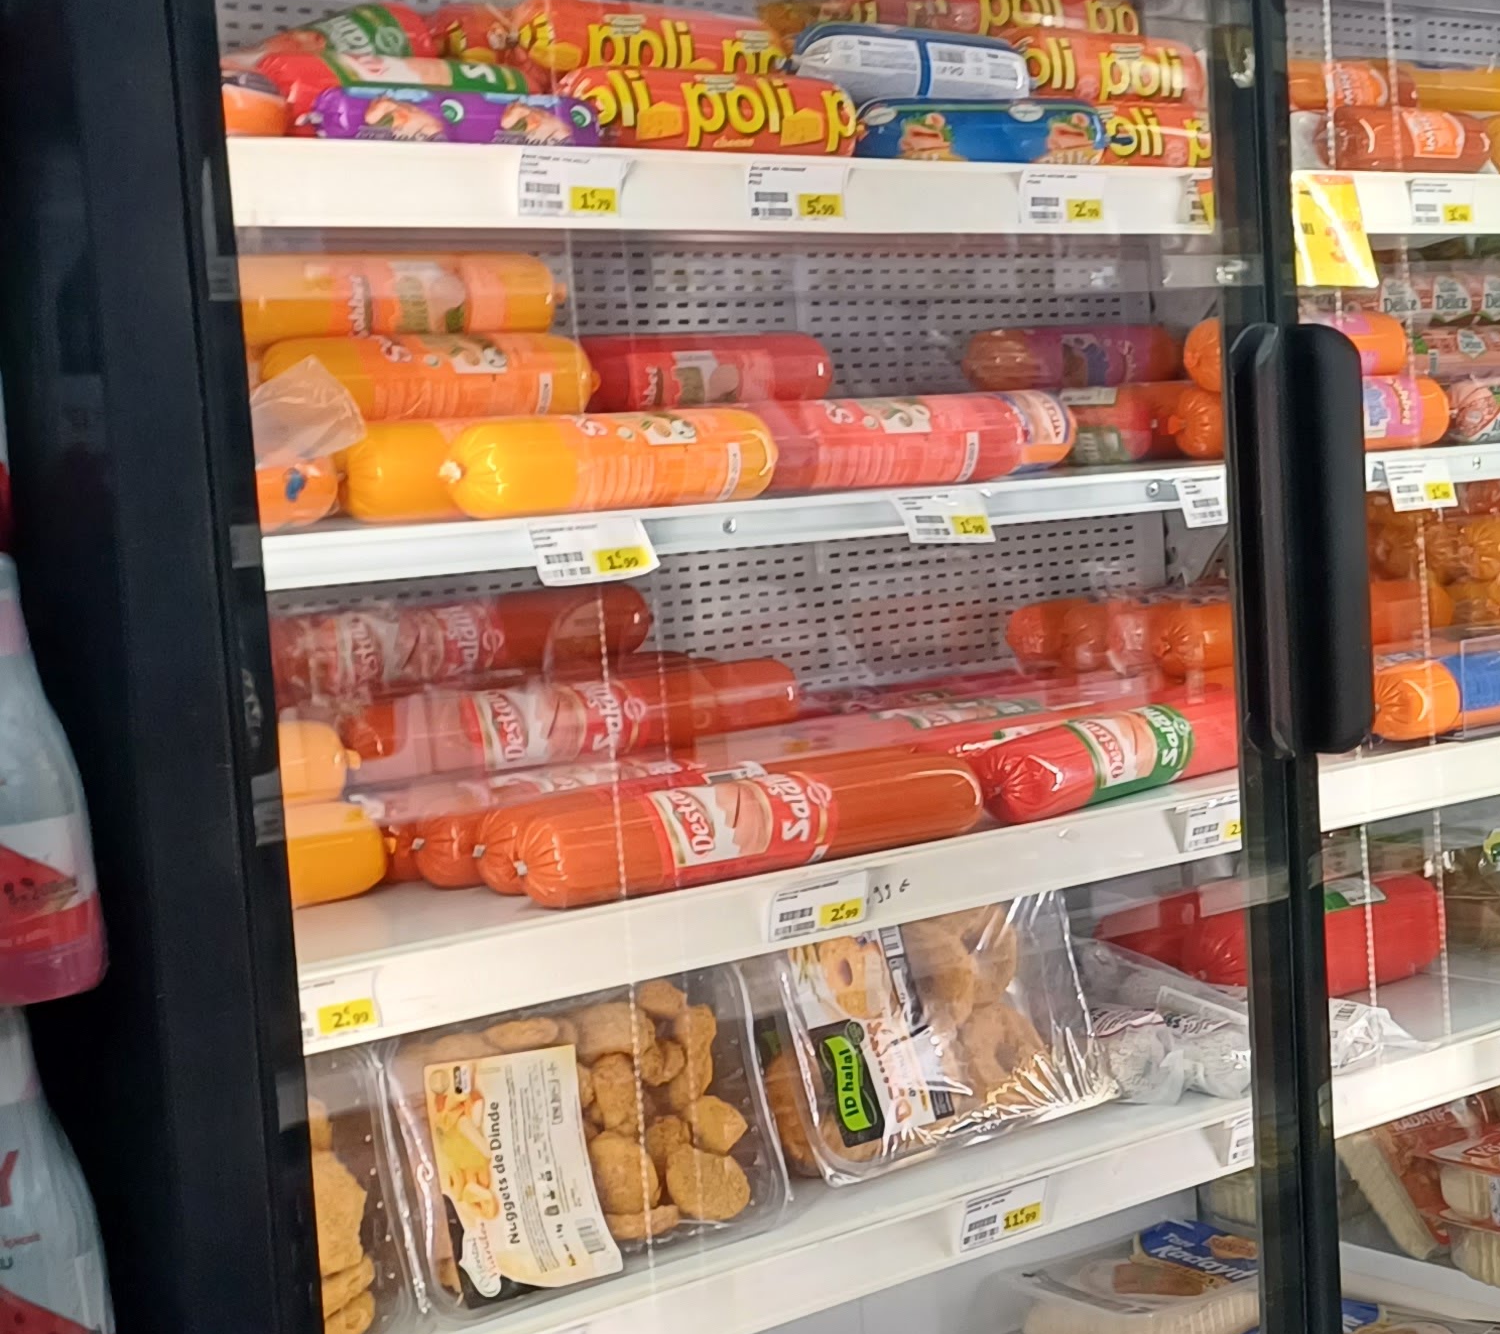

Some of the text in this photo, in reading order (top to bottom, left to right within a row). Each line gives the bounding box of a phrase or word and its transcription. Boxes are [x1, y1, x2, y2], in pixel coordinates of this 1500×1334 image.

[1098, 47, 1186, 102] poli
[681, 77, 795, 149] poli
[839, 1046, 857, 1094] halal
[487, 1100, 521, 1245] Nuggets de Dinde
